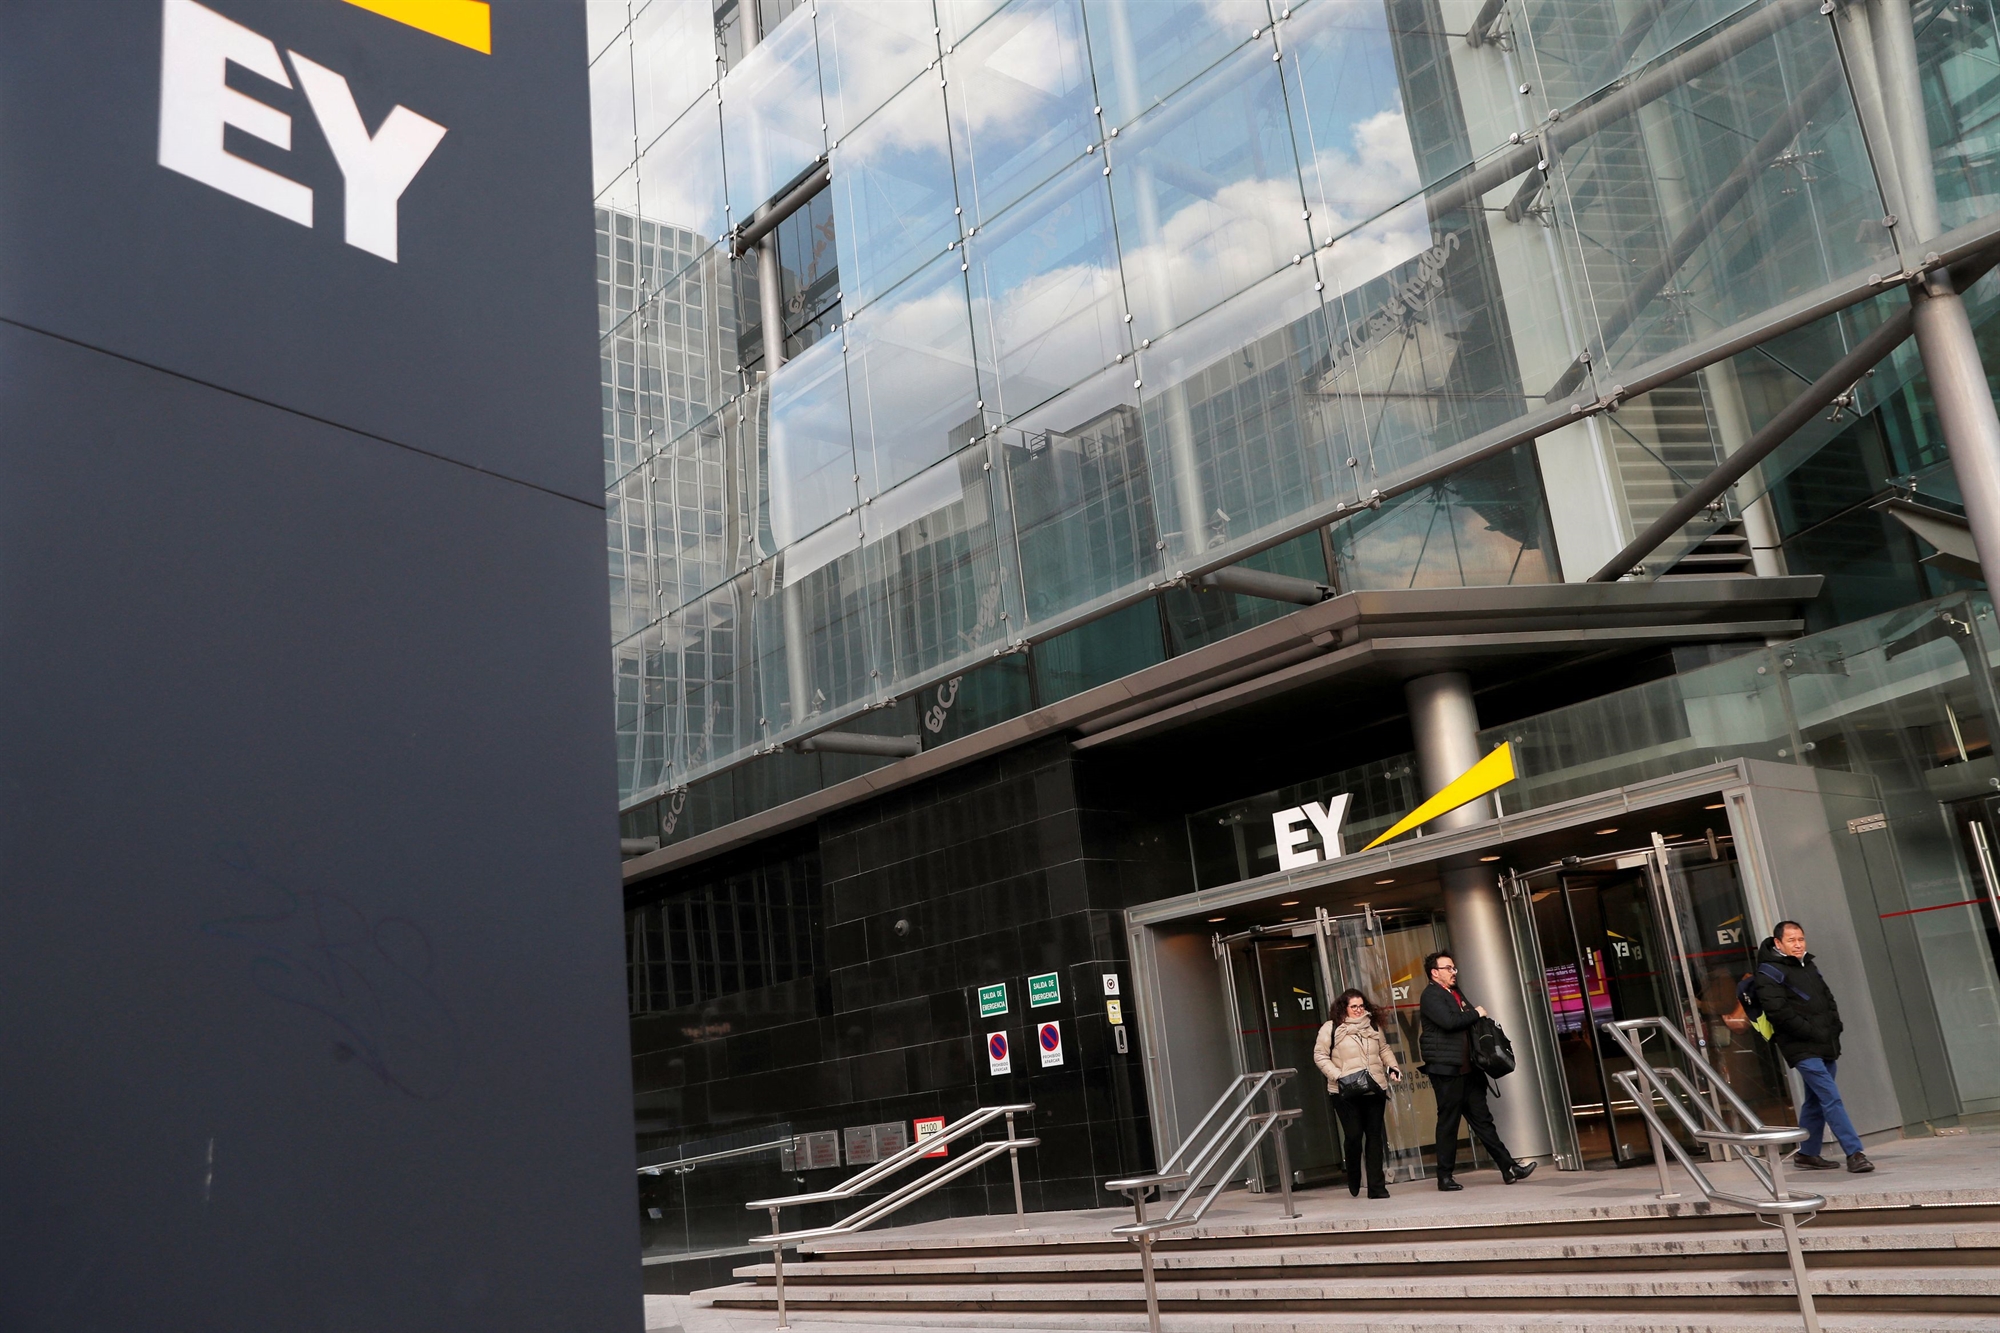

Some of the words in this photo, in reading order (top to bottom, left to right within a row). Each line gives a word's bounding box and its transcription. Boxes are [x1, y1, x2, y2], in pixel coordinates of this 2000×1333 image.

[157, 0, 448, 263] EY
[1272, 793, 1351, 871] EY
[1716, 928, 1741, 945] EY
[1033, 982, 1048, 990] SALIDA
[983, 992, 996, 1000] SALIDA
[1032, 992, 1058, 1001] EMERGENCIA
[1391, 985, 1410, 1001] EY
[982, 1003, 1005, 1011] EMERGENCIA
[920, 1123, 938, 1132] H100
